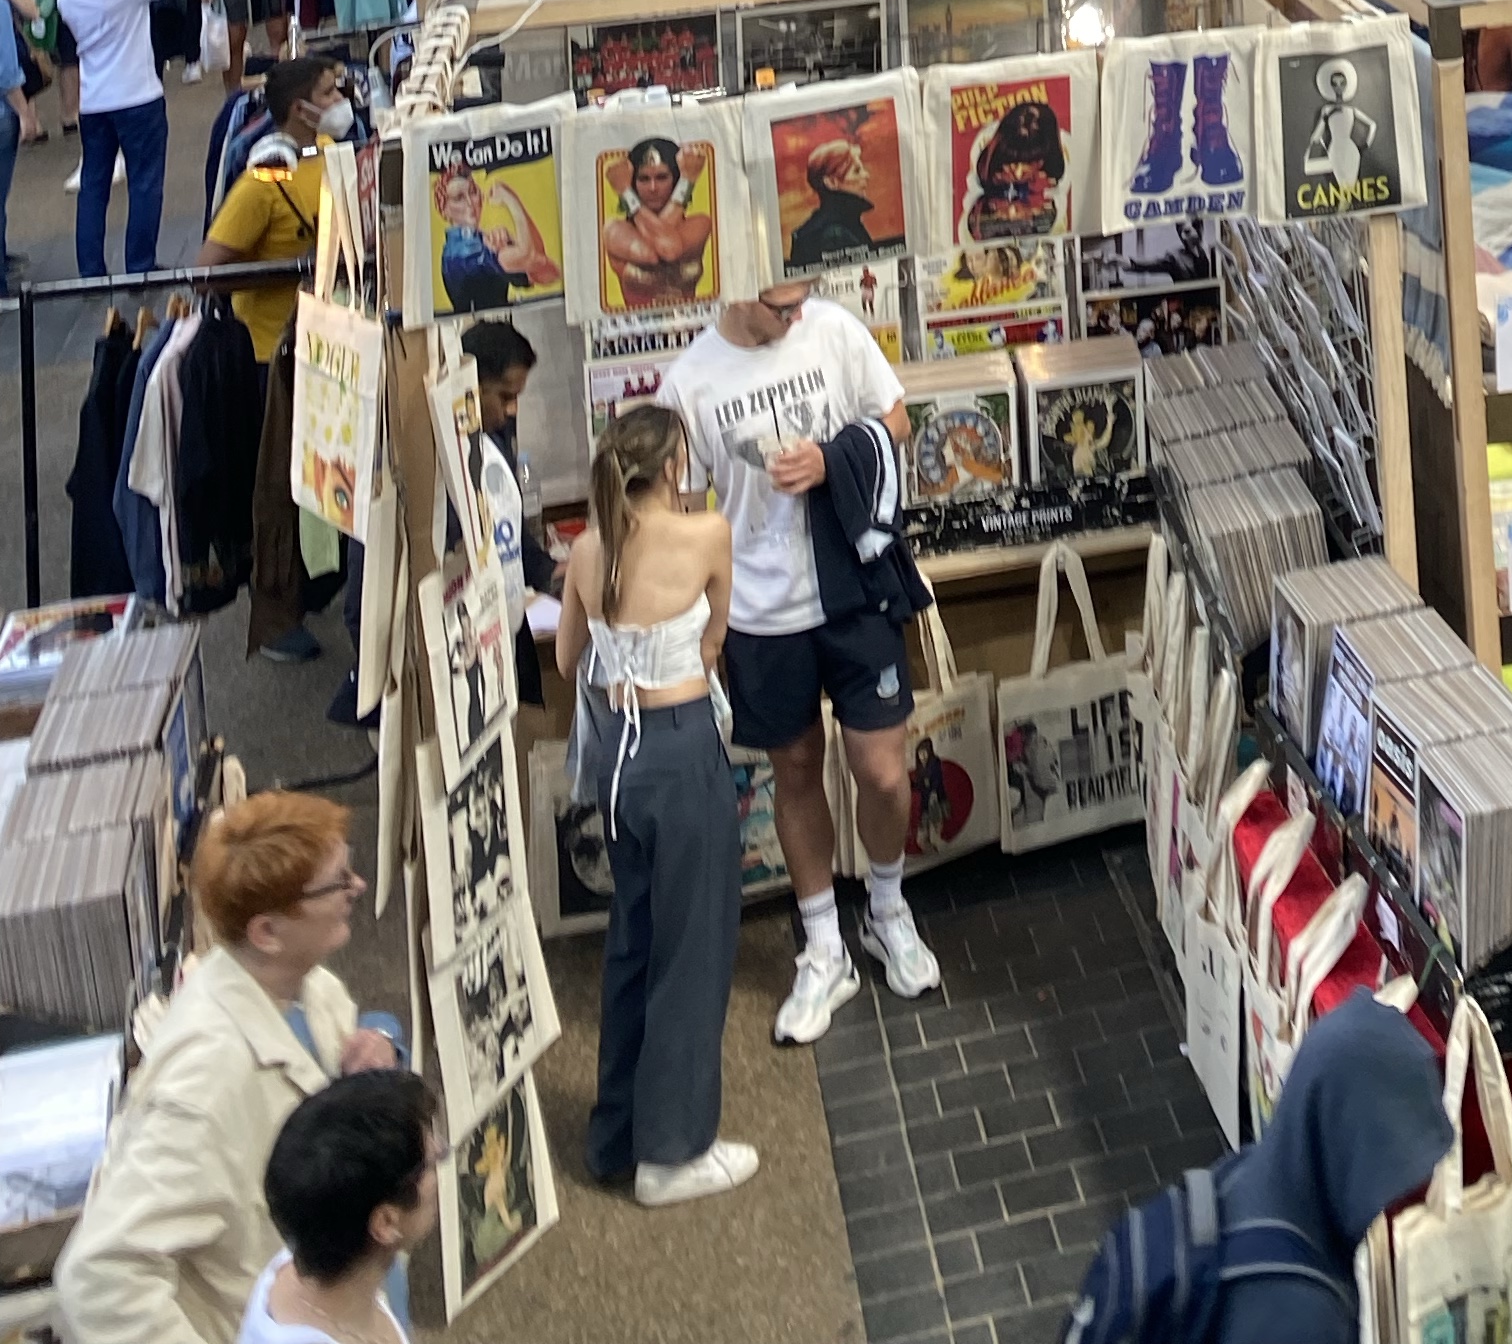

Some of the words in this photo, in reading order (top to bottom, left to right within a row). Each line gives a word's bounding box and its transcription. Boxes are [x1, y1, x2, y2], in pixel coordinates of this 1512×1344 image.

[951, 82, 998, 113] PULP
[953, 80, 1049, 134] FICTION
[432, 141, 463, 169] We
[465, 139, 494, 167] Can
[495, 133, 524, 161] Do
[1124, 191, 1246, 221] CAMDEN
[1297, 175, 1390, 210] CANNES
[714, 397, 746, 431] LED
[747, 365, 826, 418] ZEPPELIN
[980, 512, 1030, 534] VINTAGE
[1031, 505, 1074, 525] PRINTS
